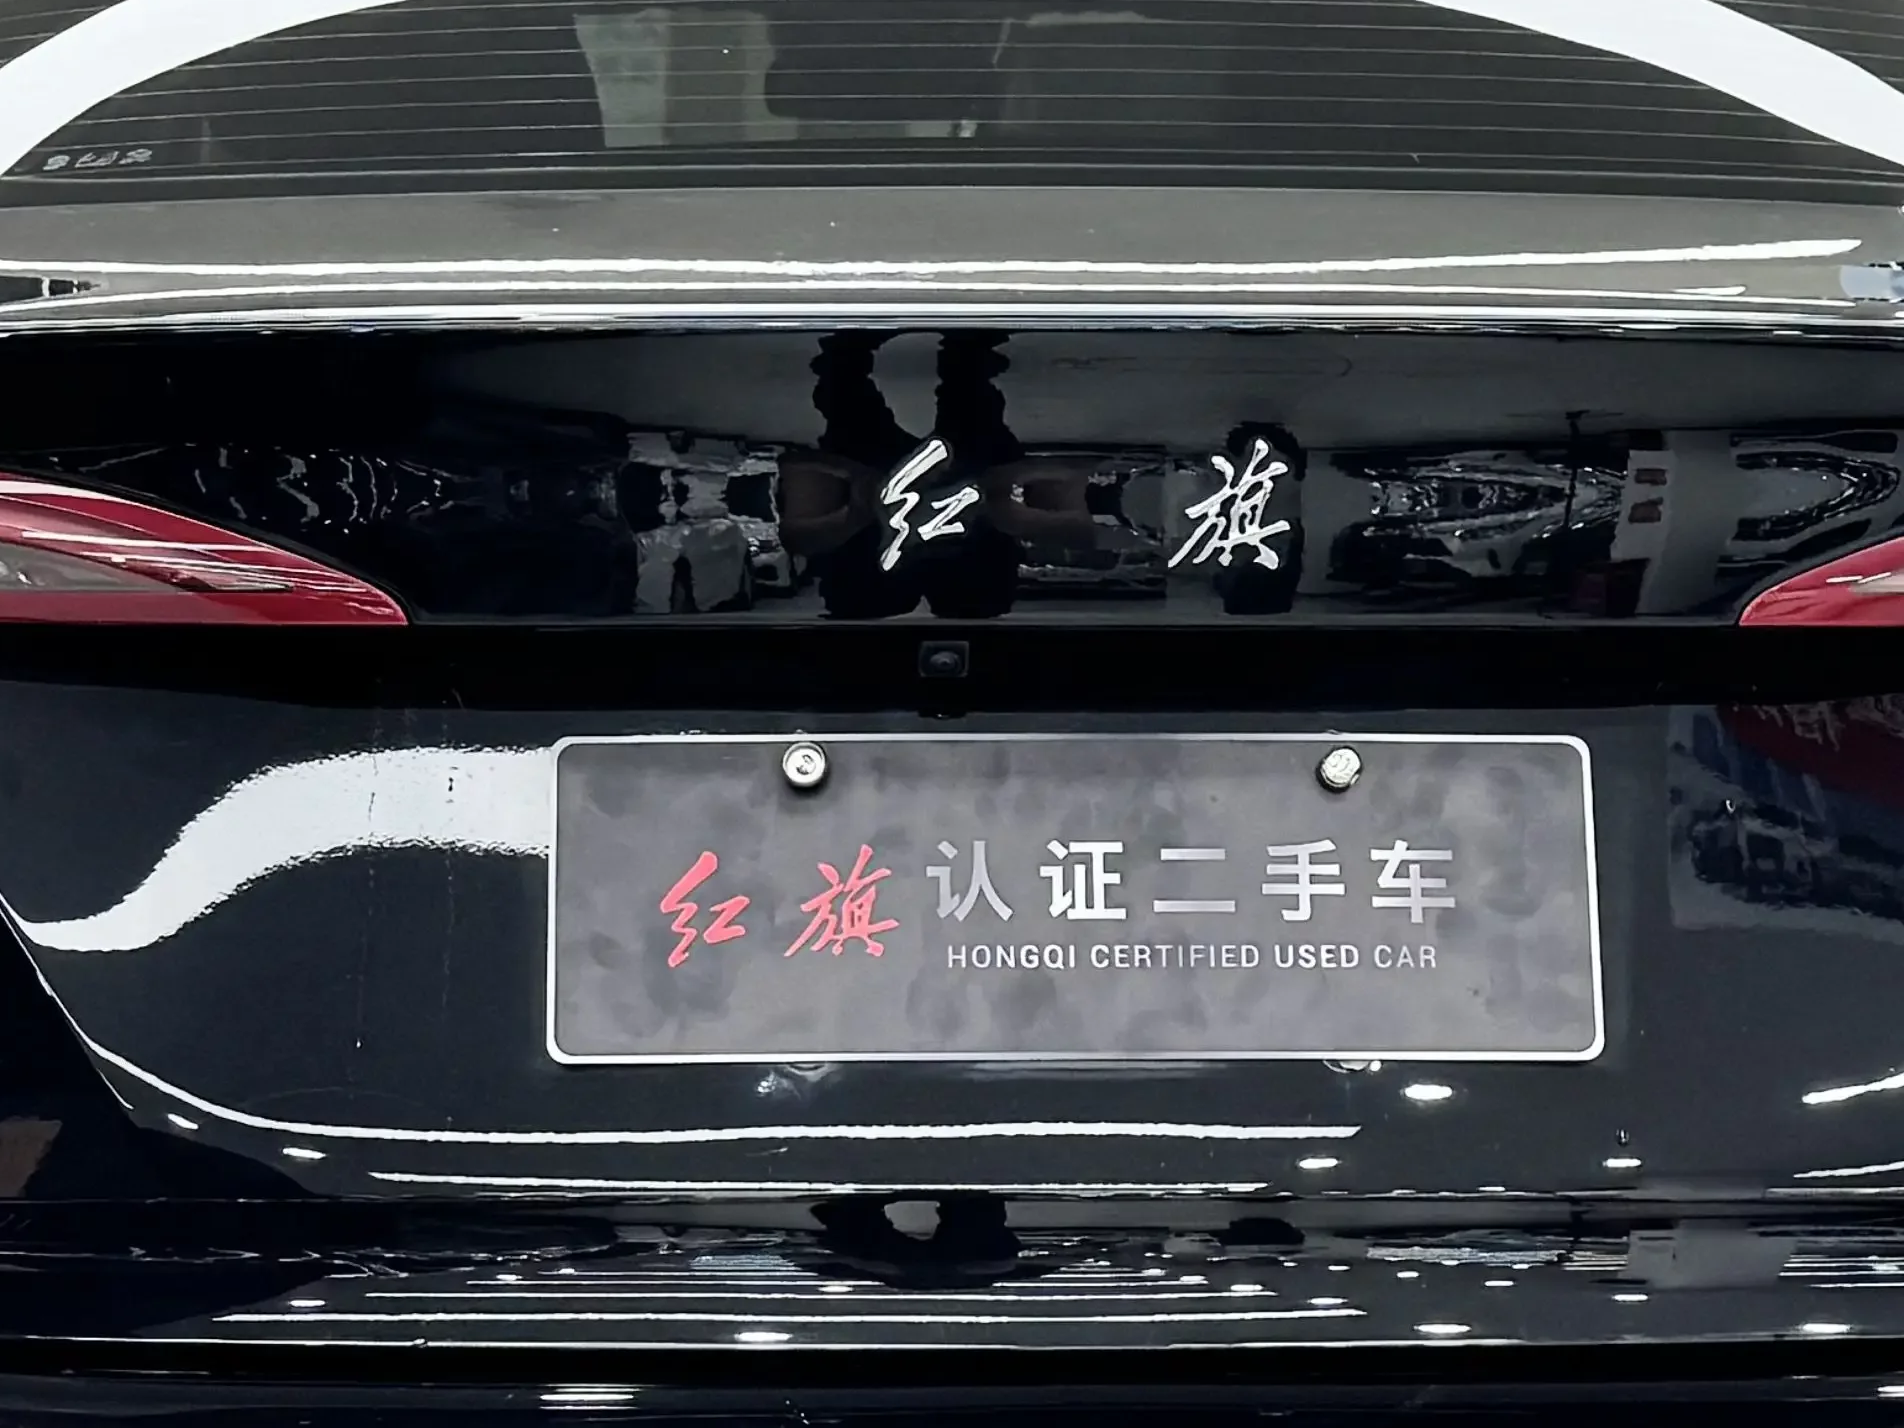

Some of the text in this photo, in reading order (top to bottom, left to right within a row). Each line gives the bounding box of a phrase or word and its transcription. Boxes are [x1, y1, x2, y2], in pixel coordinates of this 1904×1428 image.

[879, 438, 1292, 572] 红旗
[659, 838, 1458, 969] 红旗 认证二手车
[947, 943, 1438, 971] HONGQI CERTIFIED USED CAR
